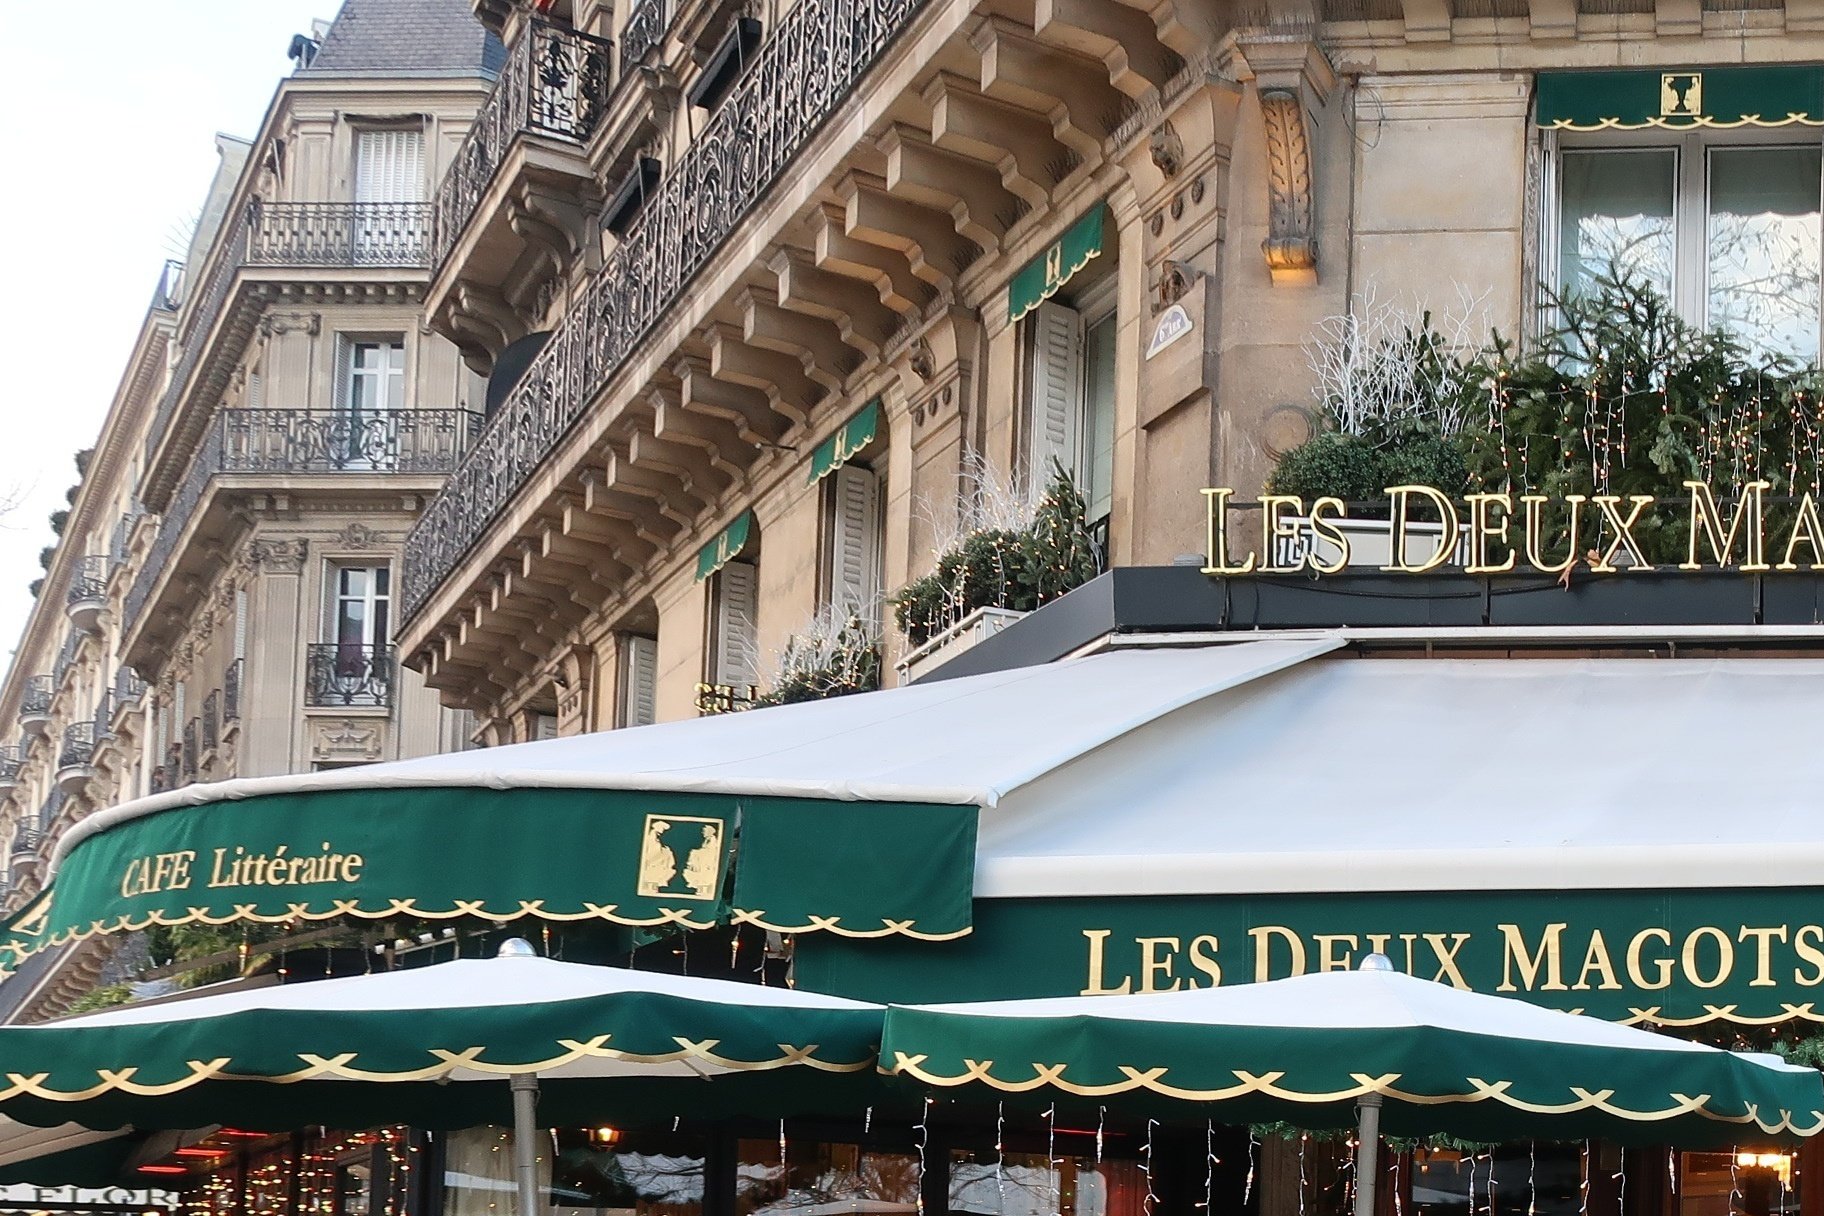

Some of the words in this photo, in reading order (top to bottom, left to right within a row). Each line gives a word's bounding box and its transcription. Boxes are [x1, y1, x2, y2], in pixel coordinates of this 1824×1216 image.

[1200, 487, 1349, 575] LES
[1379, 484, 1656, 575] DEUX
[121, 850, 196, 898] CAFE
[207, 841, 363, 889] Littéraire
[1080, 929, 1222, 997] LES
